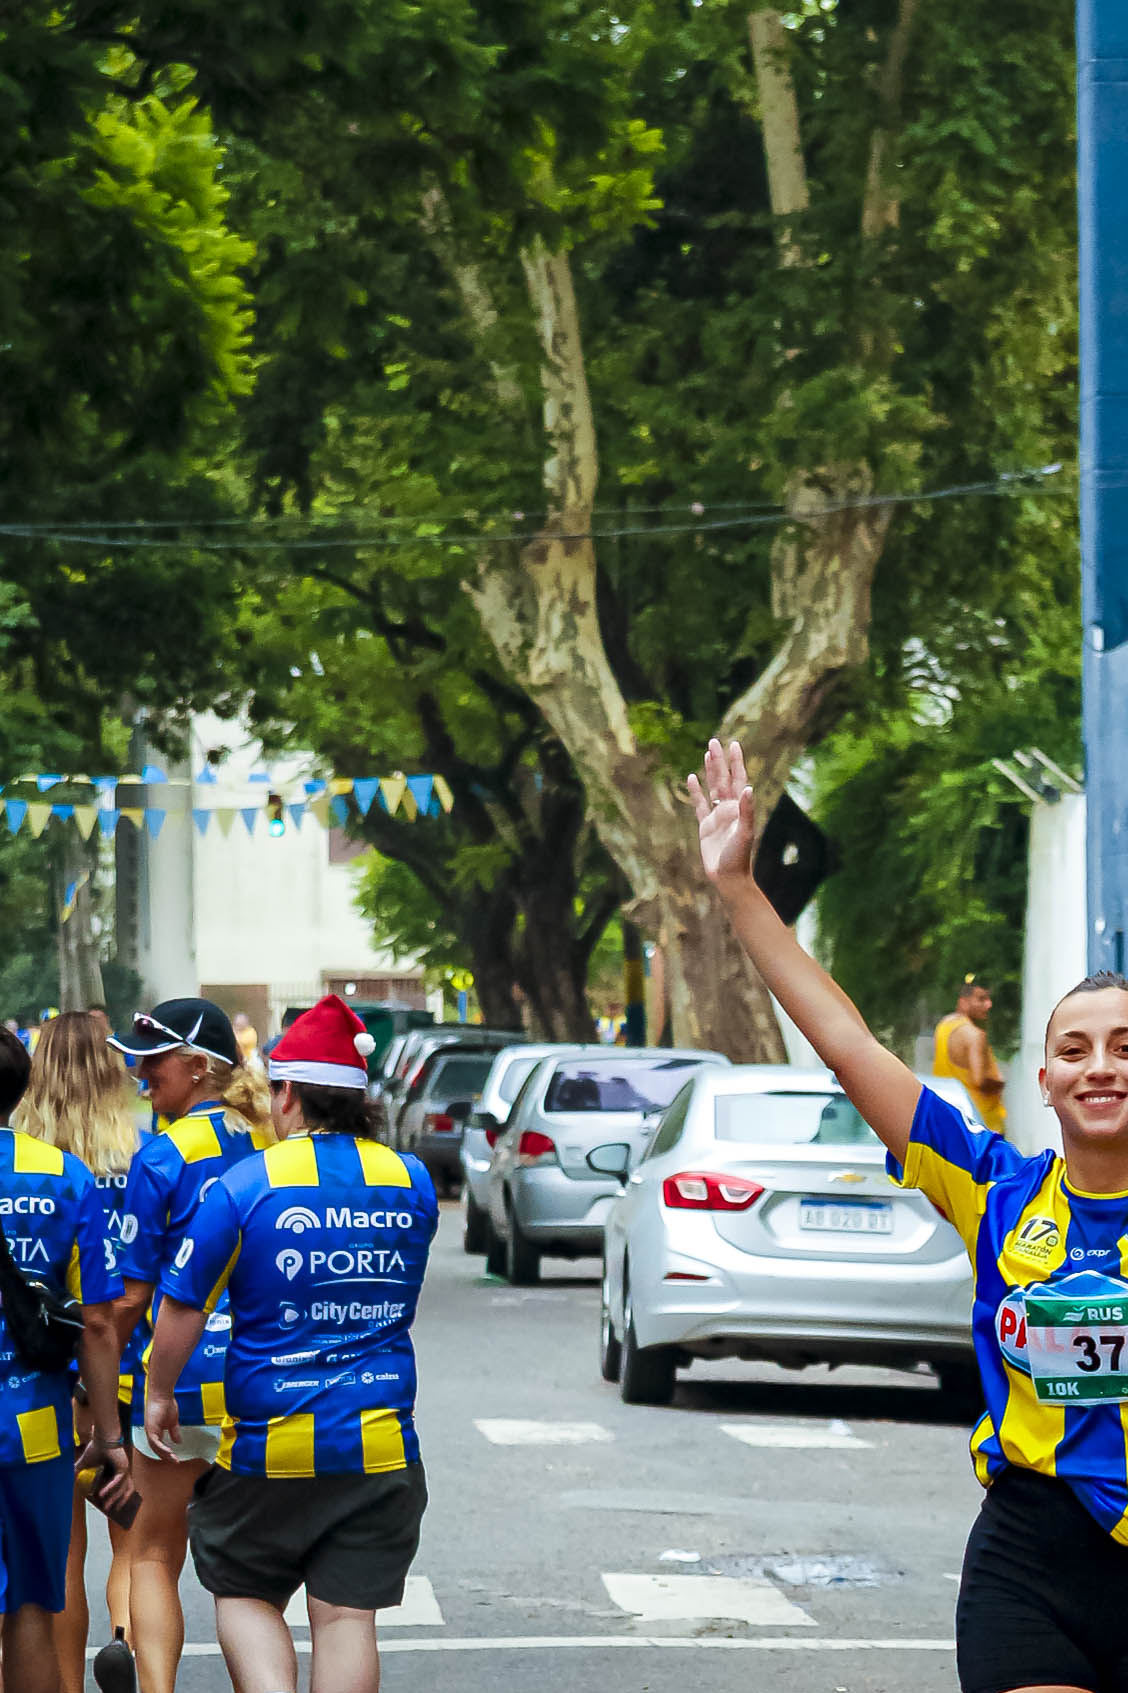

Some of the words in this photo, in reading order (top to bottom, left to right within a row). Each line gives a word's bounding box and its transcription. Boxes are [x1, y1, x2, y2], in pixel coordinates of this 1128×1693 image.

[95, 1174, 127, 1189] cro
[0, 1196, 55, 1215] acro
[325, 1207, 412, 1229] Macro
[1020, 1218, 1059, 1242] 17
[310, 1250, 406, 1274] PORTA
[1087, 1306, 1123, 1321] RUS
[1073, 1335, 1125, 1372] 37
[1046, 1381, 1080, 1396] 10K
